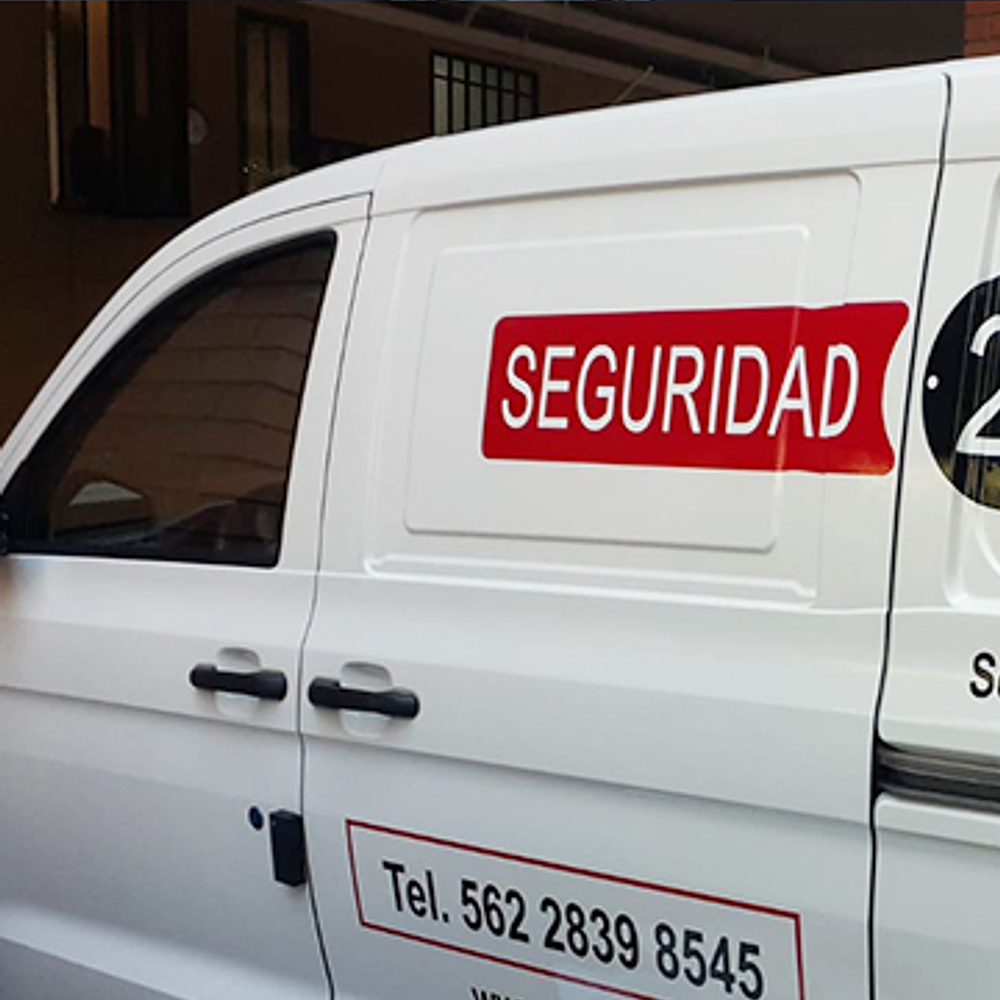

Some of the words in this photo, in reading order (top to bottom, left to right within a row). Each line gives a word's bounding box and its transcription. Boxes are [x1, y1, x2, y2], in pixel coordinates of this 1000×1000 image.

[500, 343, 860, 440] SEGURIDAD
[382, 860, 450, 924] Tel.
[460, 878, 531, 943] 562
[539, 896, 640, 969] 2839
[655, 922, 764, 1000] 8545
